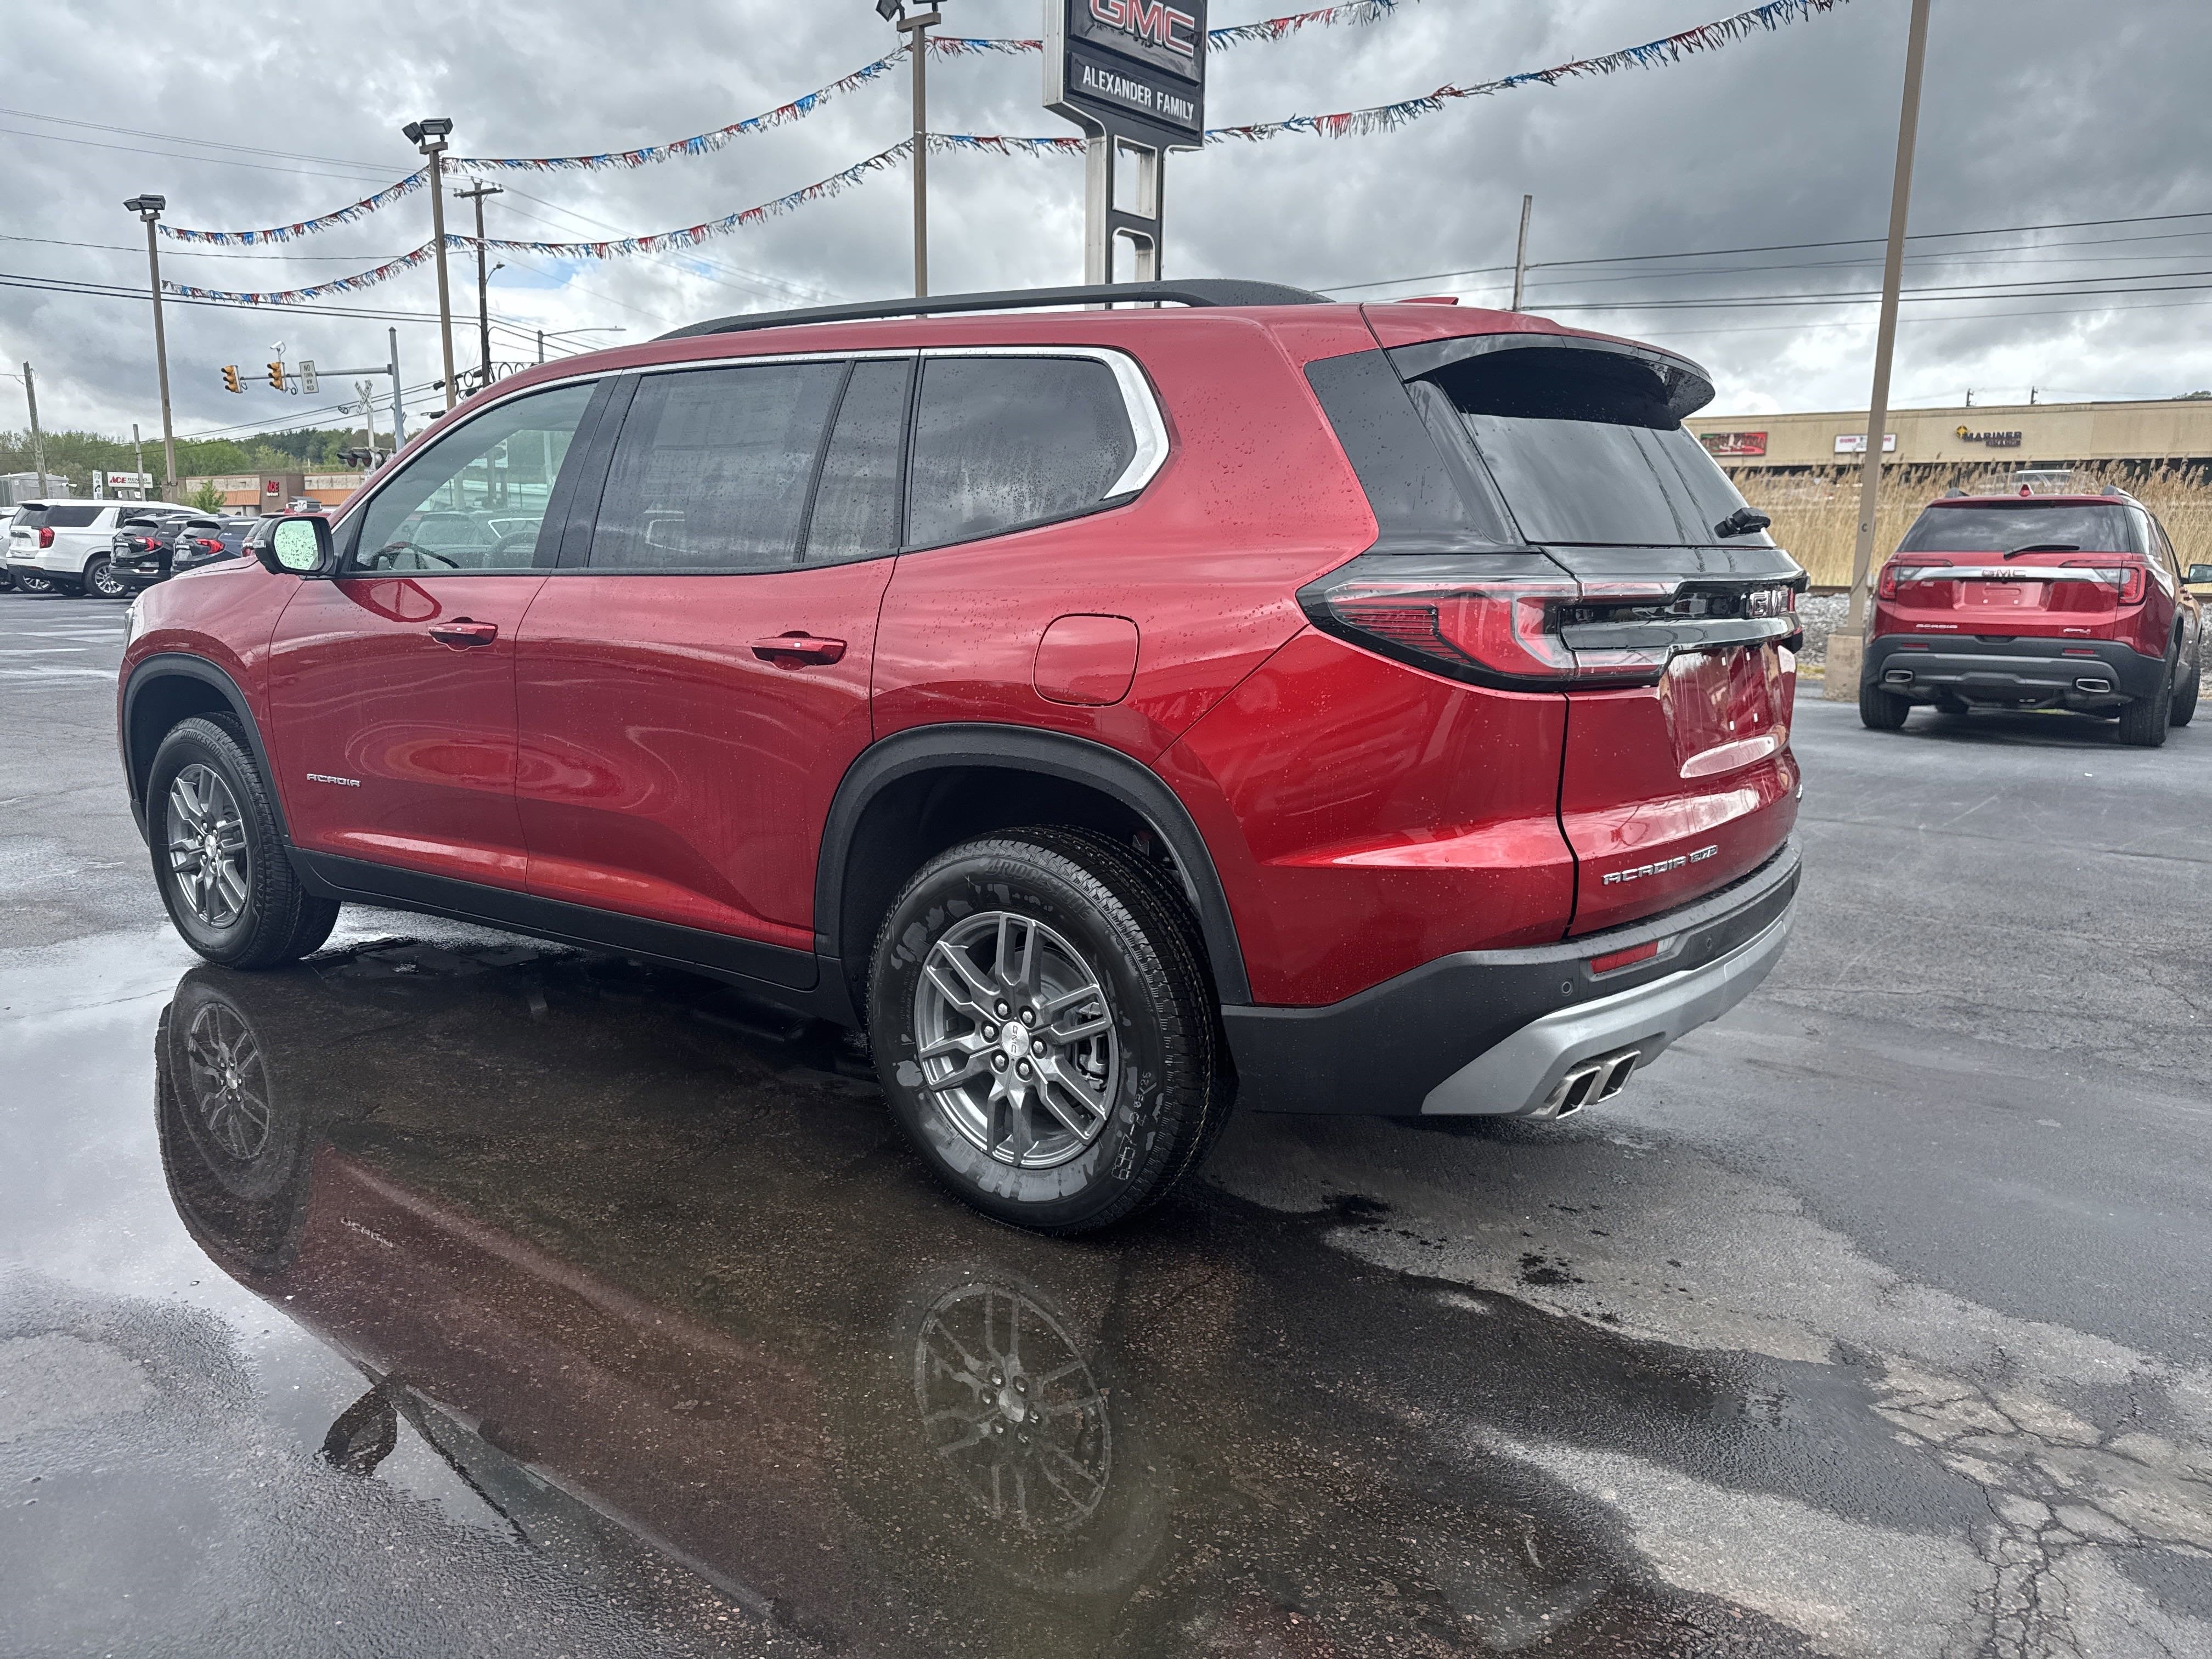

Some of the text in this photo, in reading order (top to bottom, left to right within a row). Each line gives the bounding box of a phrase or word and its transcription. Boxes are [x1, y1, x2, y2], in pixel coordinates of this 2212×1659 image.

[1090, 0, 1195, 58] GMC
[1082, 65, 1194, 122] ALEXANDER FAMILY
[356, 380, 371, 414] CROSSING
[1962, 432, 2022, 441] MARINER
[267, 480, 279, 492] ACE
[1982, 569, 2026, 577] GMC
[306, 774, 361, 788] ACADIA
[256, 856, 264, 907] ALENZA
[1602, 856, 1686, 885] ACADIA
[986, 857, 1096, 921] BRIDGESTONE
